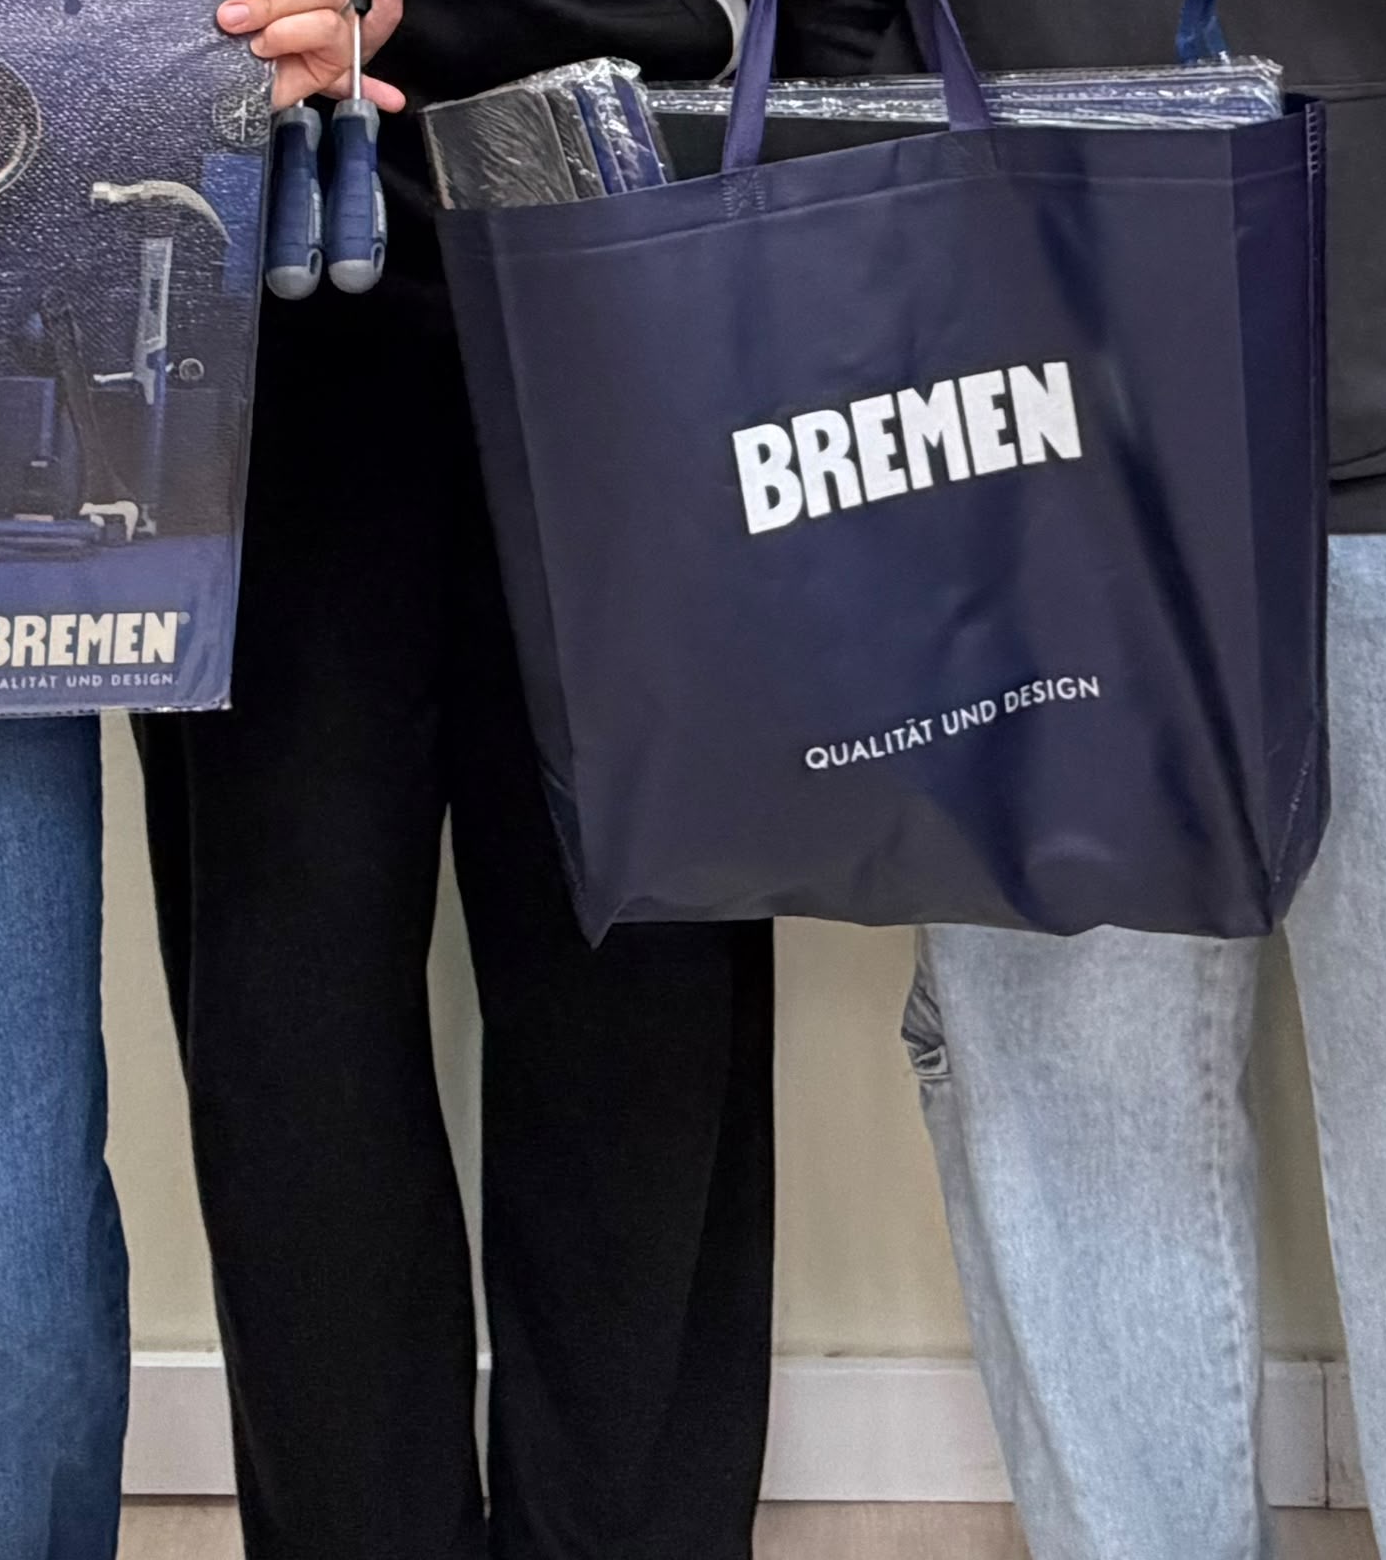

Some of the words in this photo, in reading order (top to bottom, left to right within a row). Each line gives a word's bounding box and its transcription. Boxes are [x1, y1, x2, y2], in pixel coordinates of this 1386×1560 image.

[732, 361, 1082, 535] BREMEN
[66, 673, 103, 688] UND
[110, 672, 174, 687] DESIGN
[804, 718, 933, 770] QUALITÄT
[940, 699, 997, 746] UND
[1004, 676, 1101, 714] DESIGN
